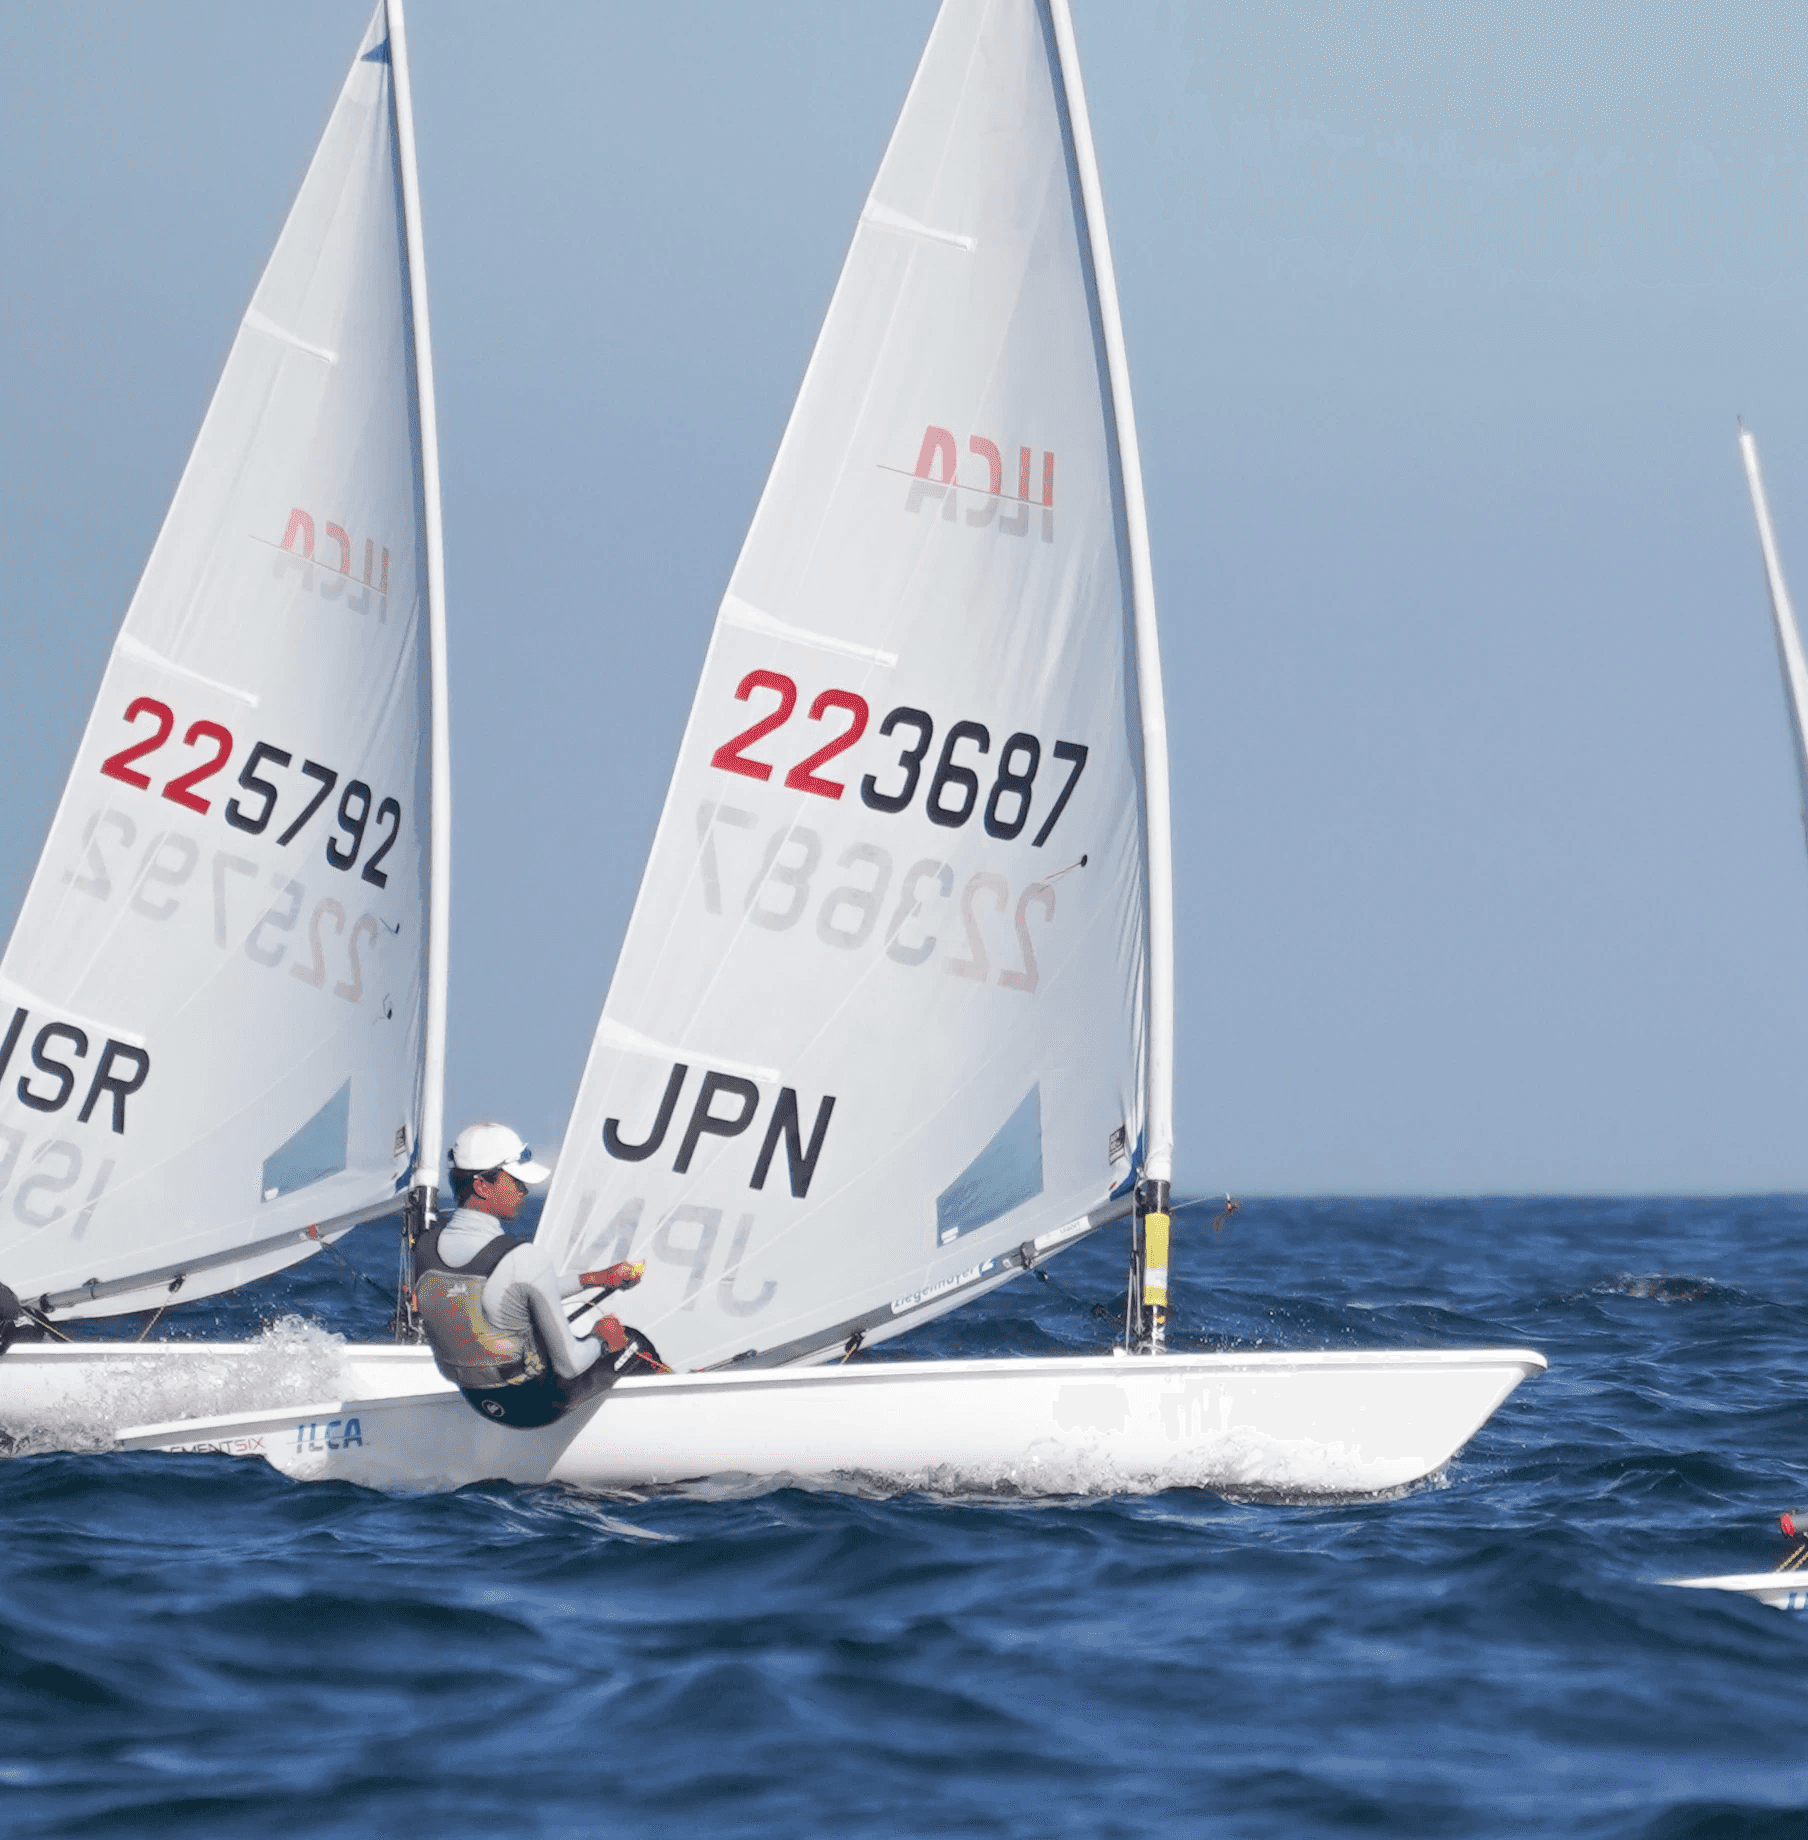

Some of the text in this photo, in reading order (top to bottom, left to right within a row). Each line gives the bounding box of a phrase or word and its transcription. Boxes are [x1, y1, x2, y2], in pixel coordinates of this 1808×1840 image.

[100, 695, 402, 890] 225792
[710, 669, 1089, 848] 223687
[0, 1007, 151, 1135] ISR
[602, 1062, 837, 1200] JPN
[296, 1417, 363, 1454] ILCA
